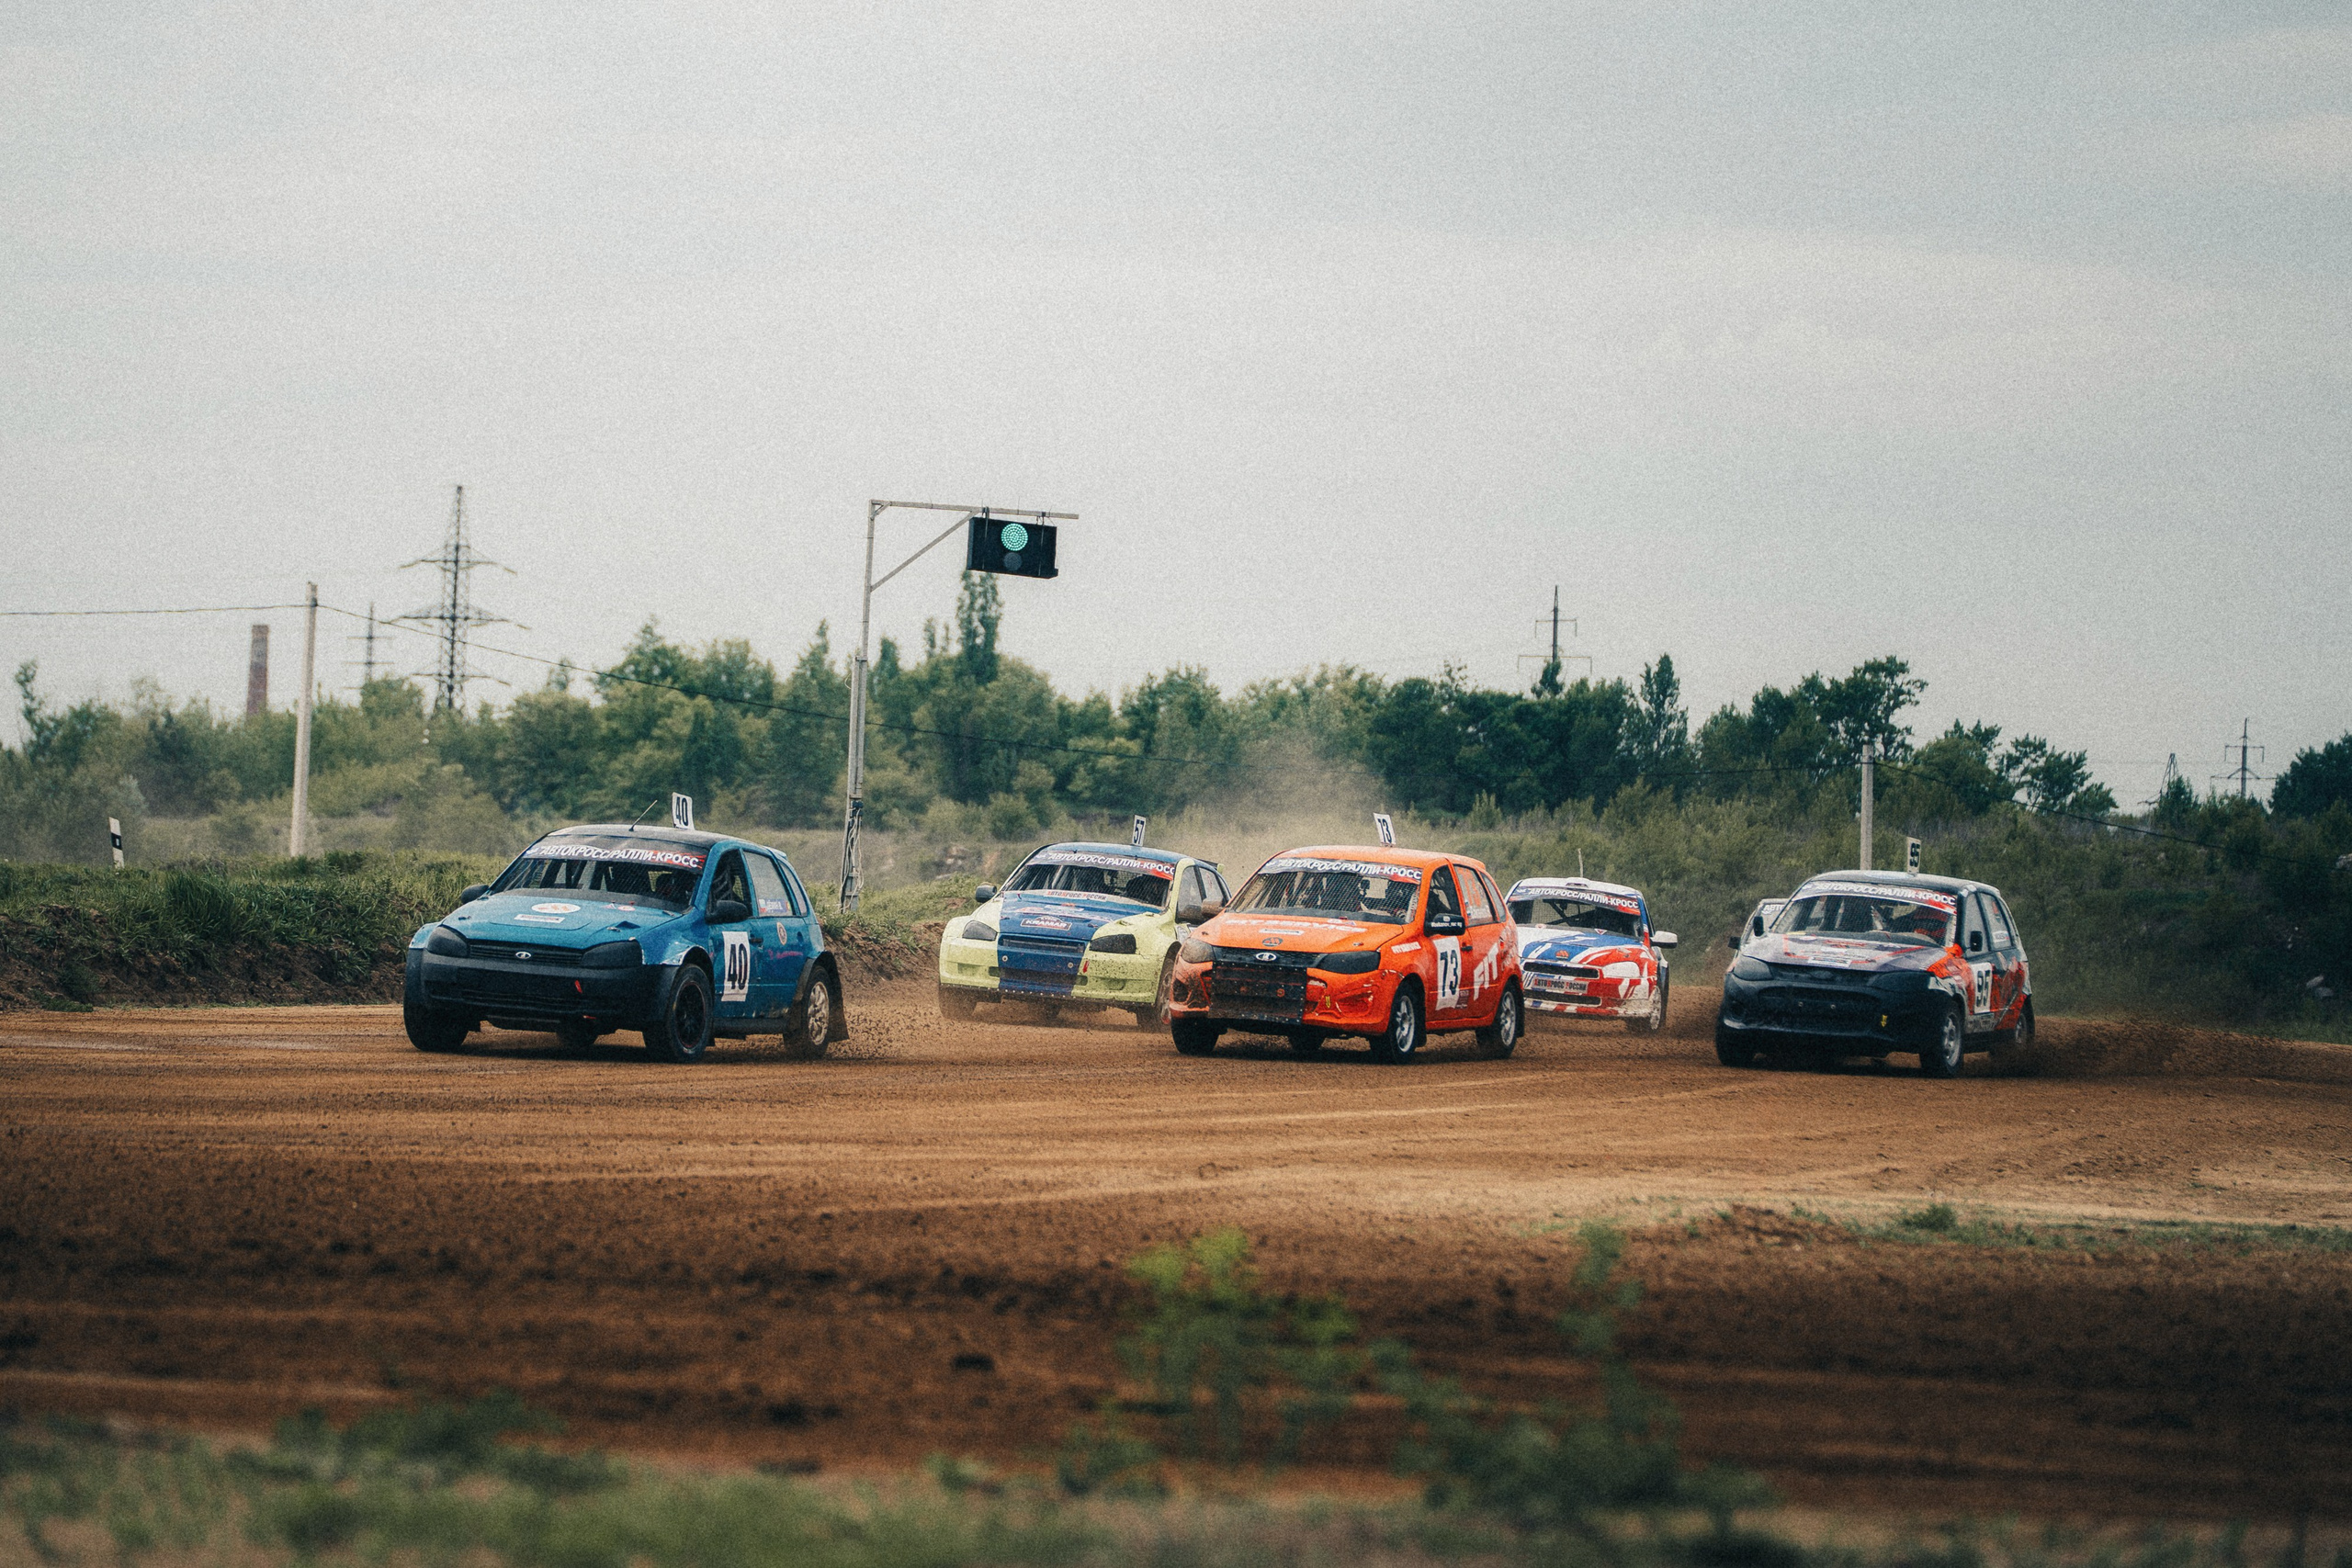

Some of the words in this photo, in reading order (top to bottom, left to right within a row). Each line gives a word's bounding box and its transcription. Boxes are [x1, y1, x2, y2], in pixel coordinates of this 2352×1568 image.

[675, 795, 689, 827] 40
[1134, 818, 1145, 845] 57
[1909, 842, 1920, 868] 95
[1025, 919, 1068, 928] KRAMAR
[727, 943, 748, 991] 40
[1440, 950, 1459, 998] 73
[1473, 942, 1499, 1001] FIT
[1975, 969, 1992, 1008] 95
